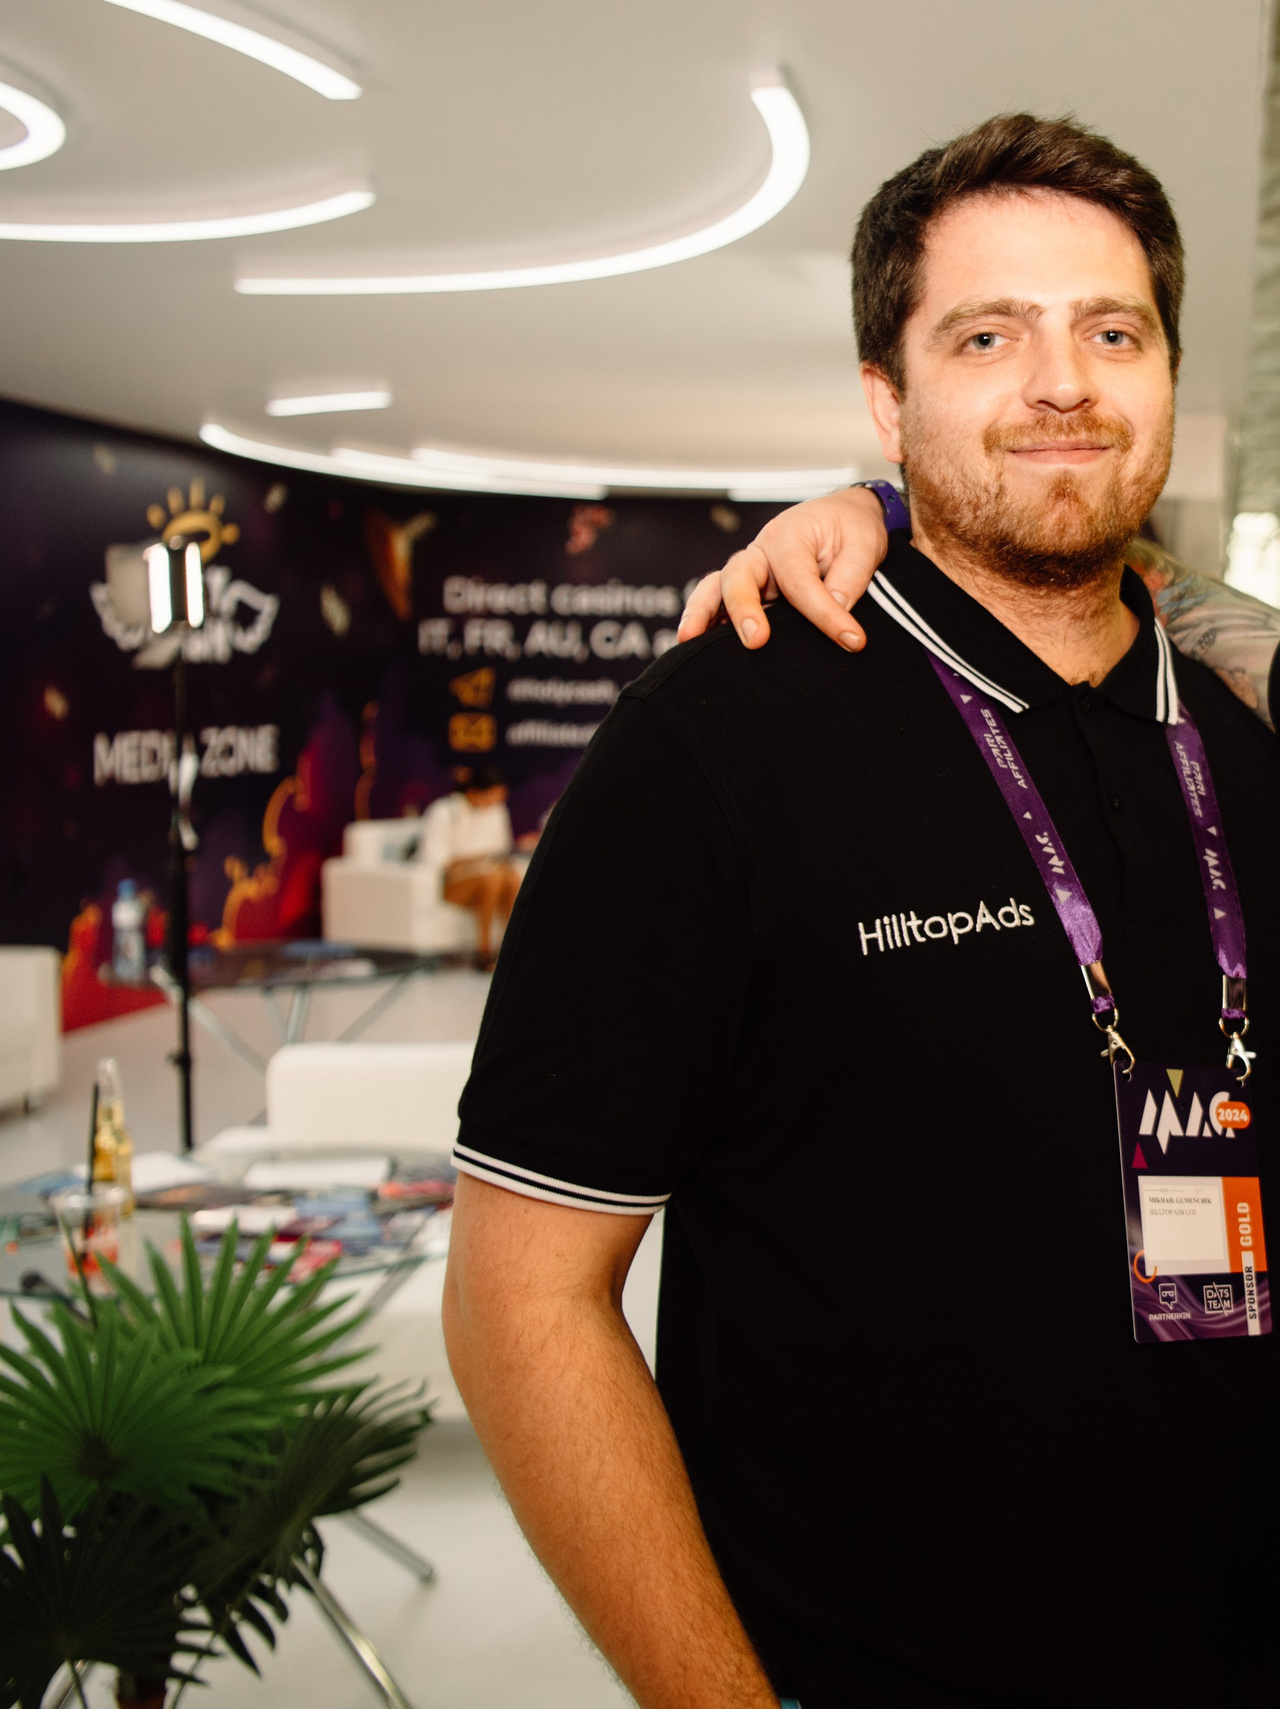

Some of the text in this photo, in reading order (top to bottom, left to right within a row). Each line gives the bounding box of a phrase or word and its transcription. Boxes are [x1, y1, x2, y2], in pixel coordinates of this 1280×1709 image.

[444, 576, 547, 615] Direct
[551, 578, 680, 617] casinos
[590, 620, 650, 660] CA
[93, 724, 279, 784] MEDI ZONE
[981, 708, 1028, 789] AFFILIATES
[858, 897, 1035, 956] HilltopAds
[1217, 1107, 1249, 1122] 2024
[1237, 1202, 1253, 1247] GOLD
[1206, 1288, 1230, 1299] DATS
[1207, 1299, 1231, 1310] TEAM
[1245, 1265, 1257, 1320] SPONSOR
[1148, 1311, 1191, 1321] PARTNERKIN
